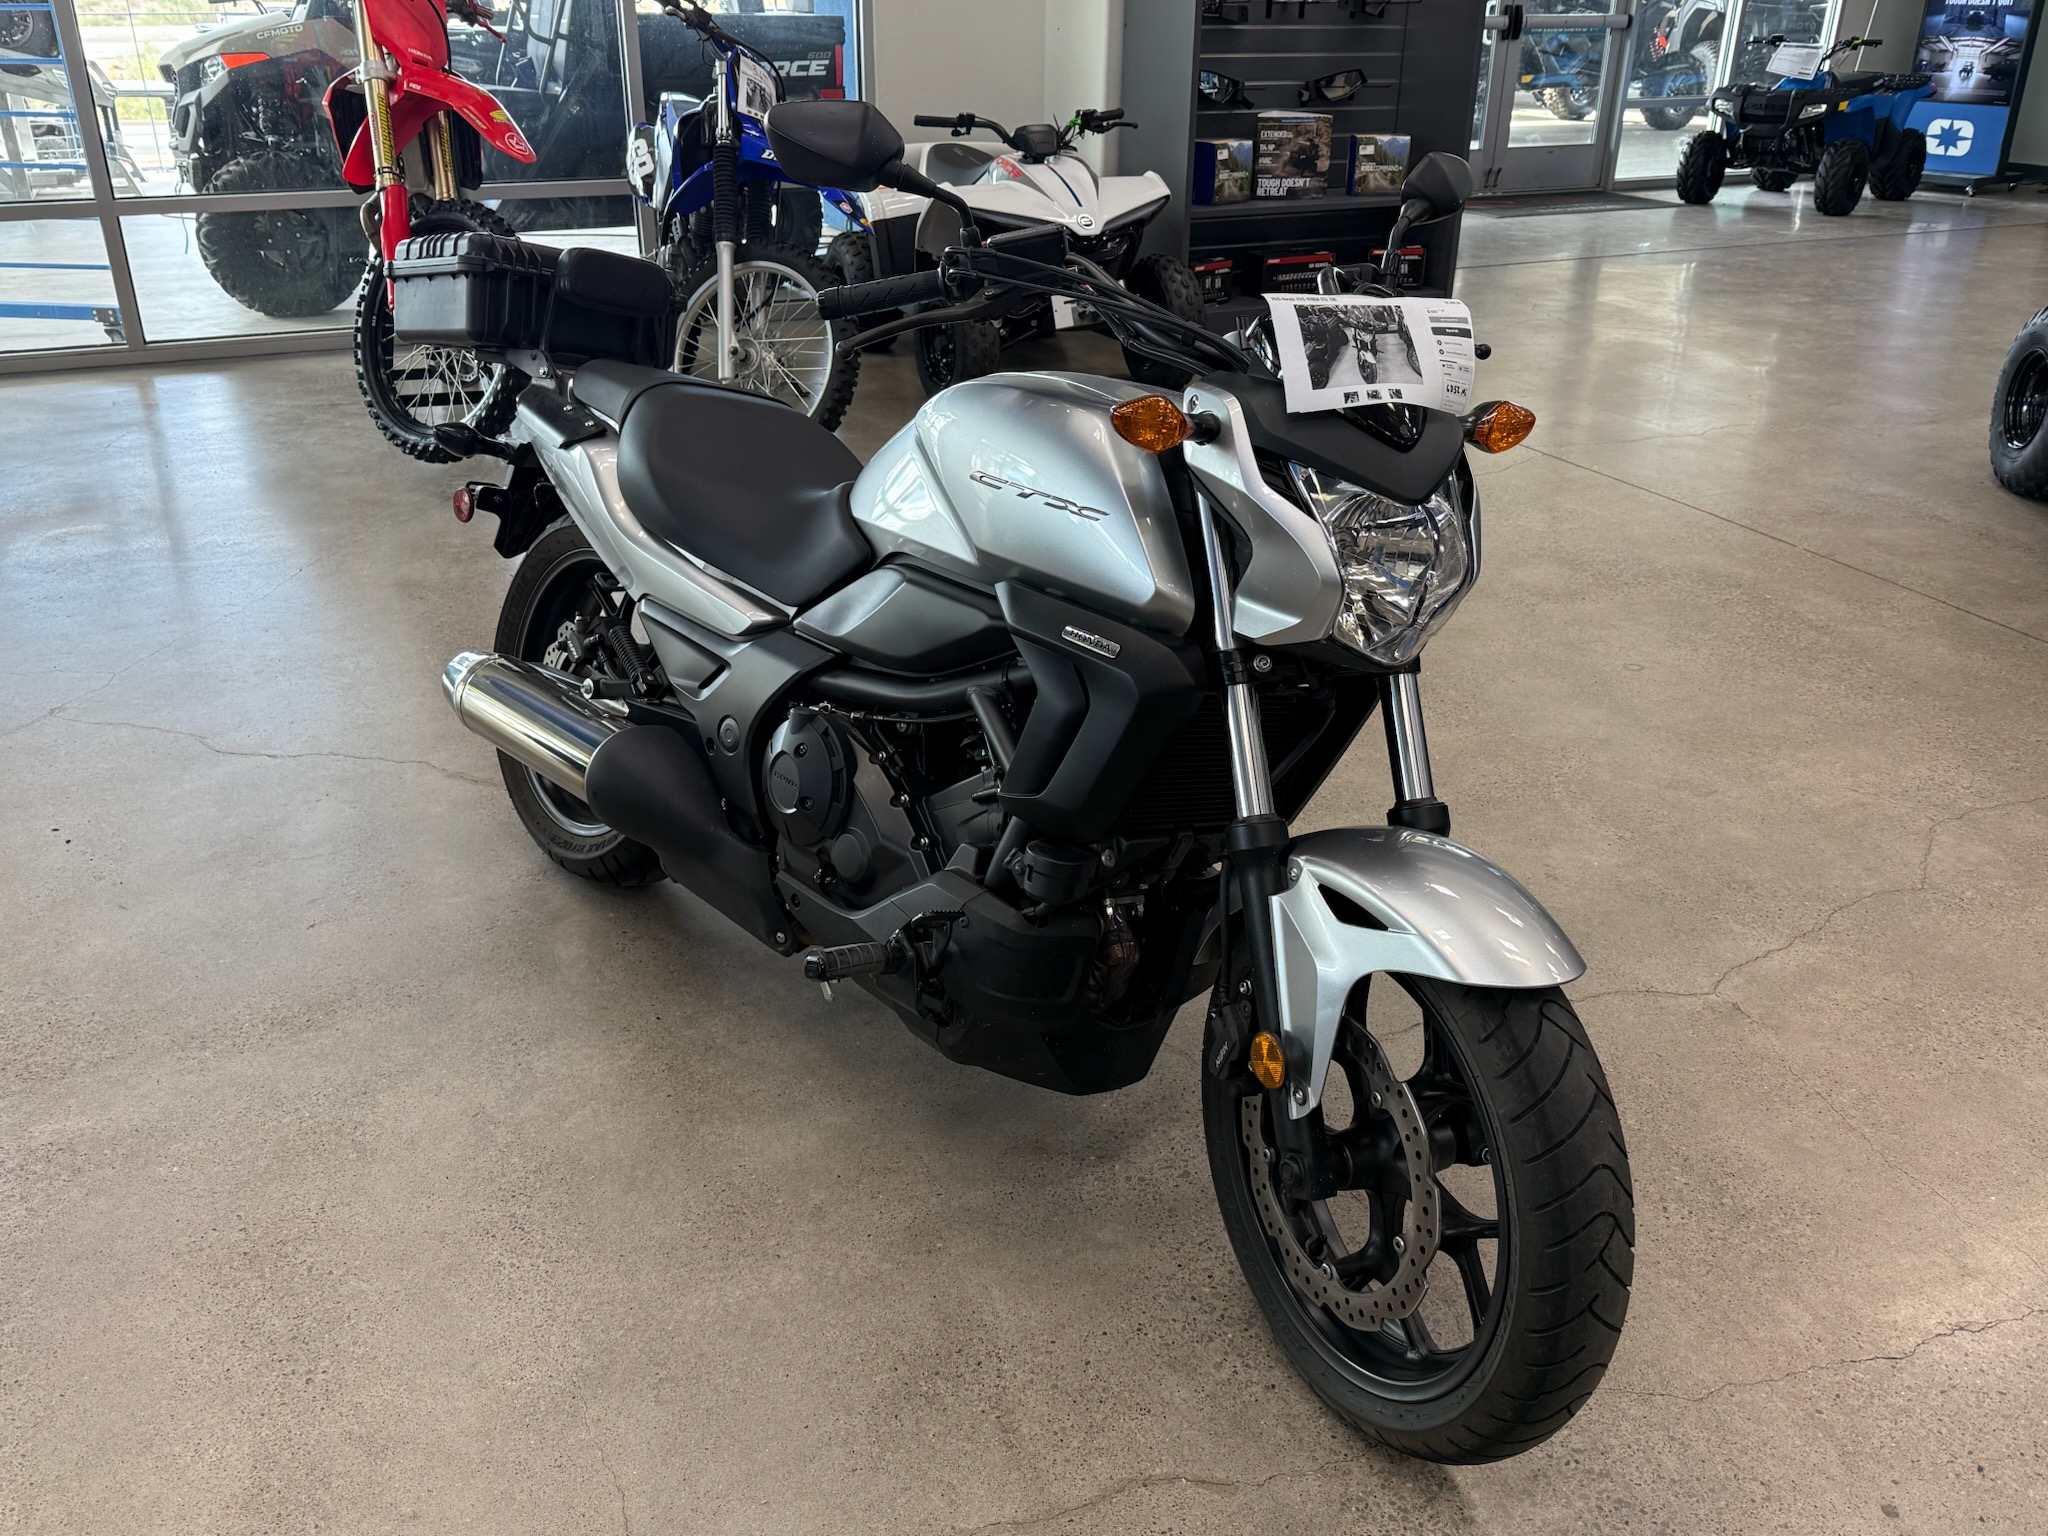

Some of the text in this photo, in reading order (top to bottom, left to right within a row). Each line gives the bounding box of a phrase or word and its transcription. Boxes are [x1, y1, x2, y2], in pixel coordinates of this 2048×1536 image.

[256, 24, 303, 39] CFMOTO
[407, 47, 433, 61] HONDA
[807, 51, 832, 59] 600
[1258, 178, 1311, 187] TOUGH DOESN'T
[1256, 187, 1288, 196] RETREAT
[970, 471, 1110, 521] CTX
[1067, 629, 1113, 655] HONDA
